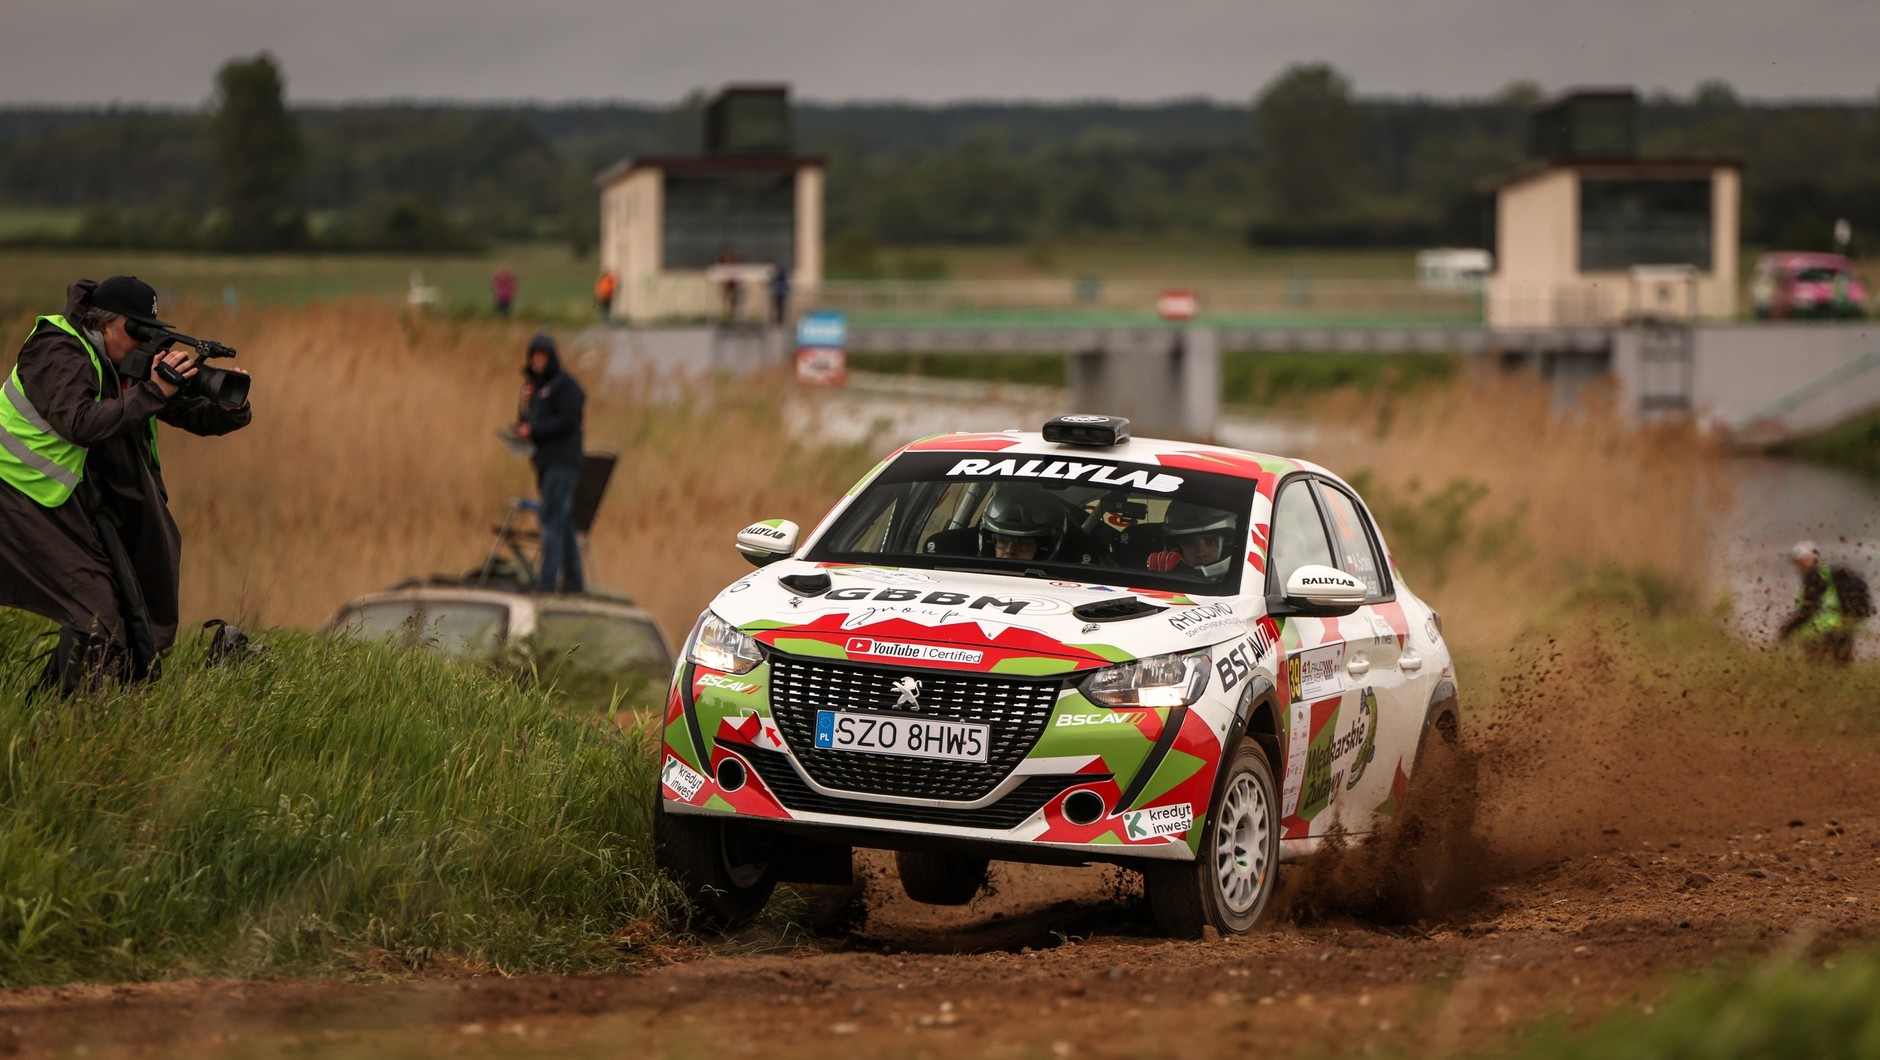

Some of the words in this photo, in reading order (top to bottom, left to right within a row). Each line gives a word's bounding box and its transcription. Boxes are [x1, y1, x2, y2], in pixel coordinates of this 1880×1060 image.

[946, 458, 1184, 493] RALLYLAB
[1302, 578, 1355, 587] RALLYLAB
[825, 587, 1031, 616] GBBM
[845, 604, 963, 627] group
[873, 642, 919, 658] YouTube
[929, 647, 982, 663] Certified
[1216, 631, 1266, 694] BSCAV
[696, 673, 752, 692] BSCAV
[1289, 658, 1301, 698] 39
[1055, 713, 1130, 727] BSCAV
[820, 733, 830, 742] PL
[837, 718, 897, 750] SZO
[907, 723, 982, 757] 8HW5
[679, 765, 703, 789] kredyt
[671, 777, 694, 801] inwest
[1149, 804, 1191, 822] kredyt
[1153, 817, 1191, 834] inwest
